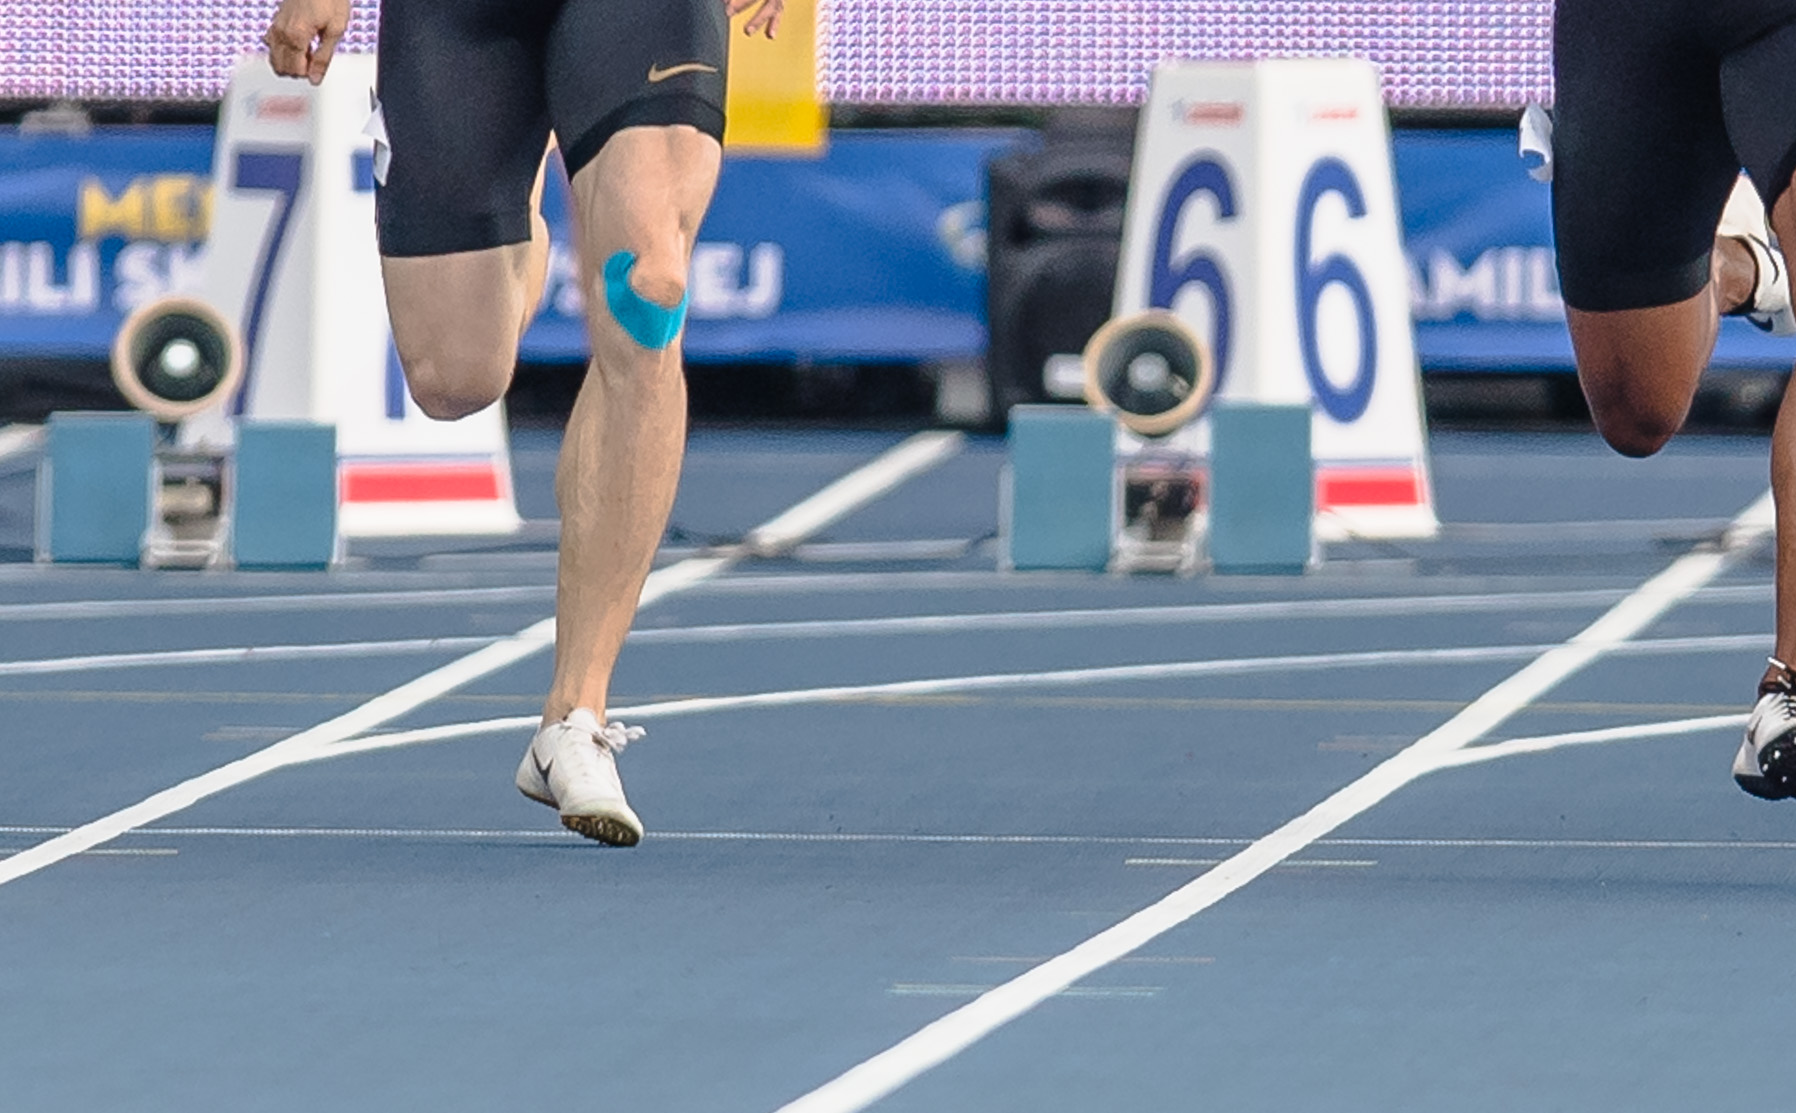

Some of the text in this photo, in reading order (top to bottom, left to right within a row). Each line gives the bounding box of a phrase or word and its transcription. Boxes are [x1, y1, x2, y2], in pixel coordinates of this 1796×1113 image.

[229, 142, 310, 421] 7
[1148, 148, 1243, 413] 6
[1294, 155, 1378, 425] 6
